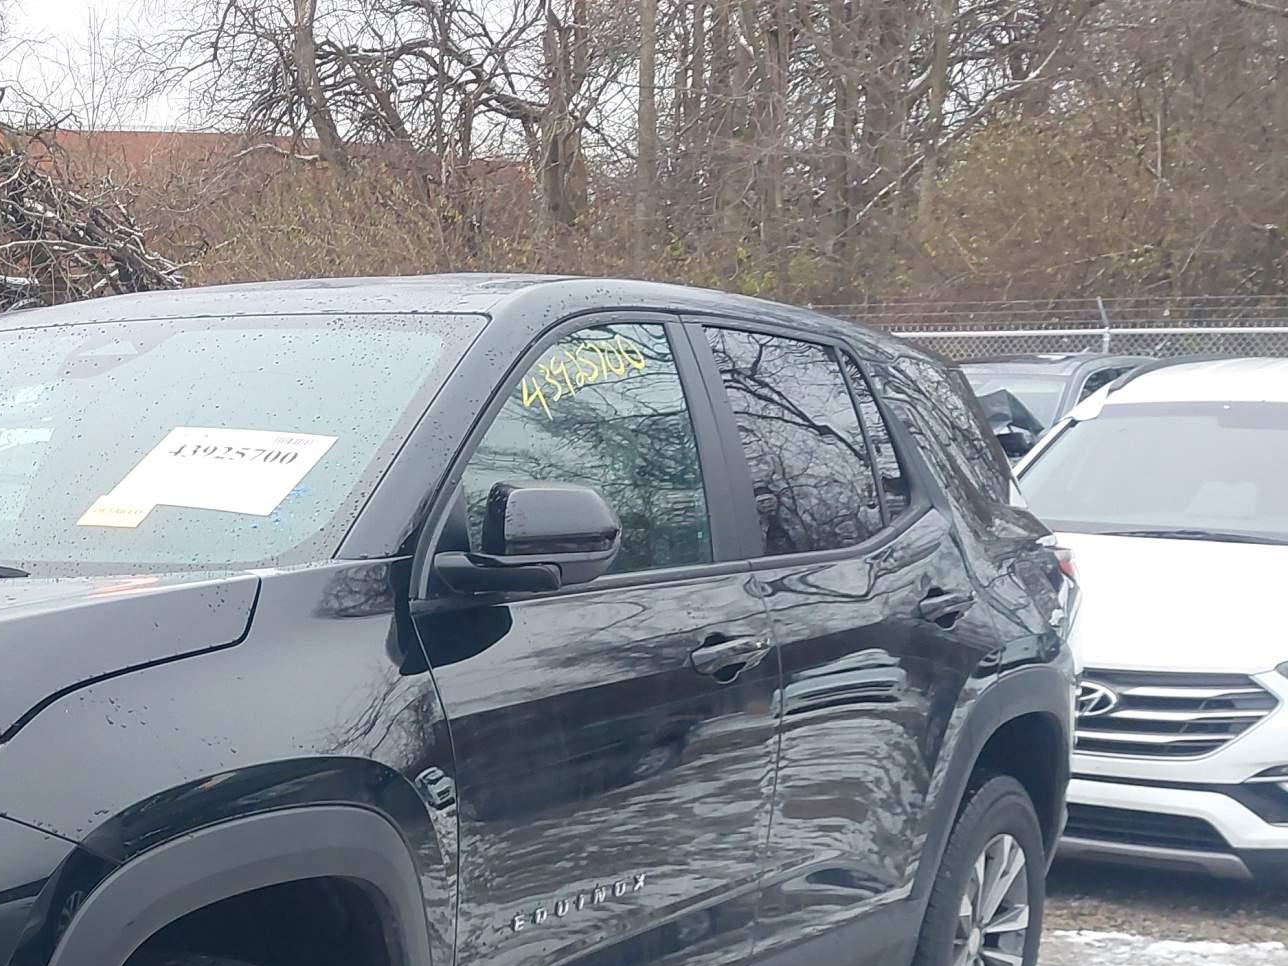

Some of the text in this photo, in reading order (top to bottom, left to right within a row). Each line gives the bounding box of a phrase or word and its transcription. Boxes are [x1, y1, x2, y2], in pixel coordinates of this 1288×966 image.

[520, 334, 646, 420] 43925700
[168, 444, 299, 465] 43925700
[513, 873, 646, 932] EQUINOX
